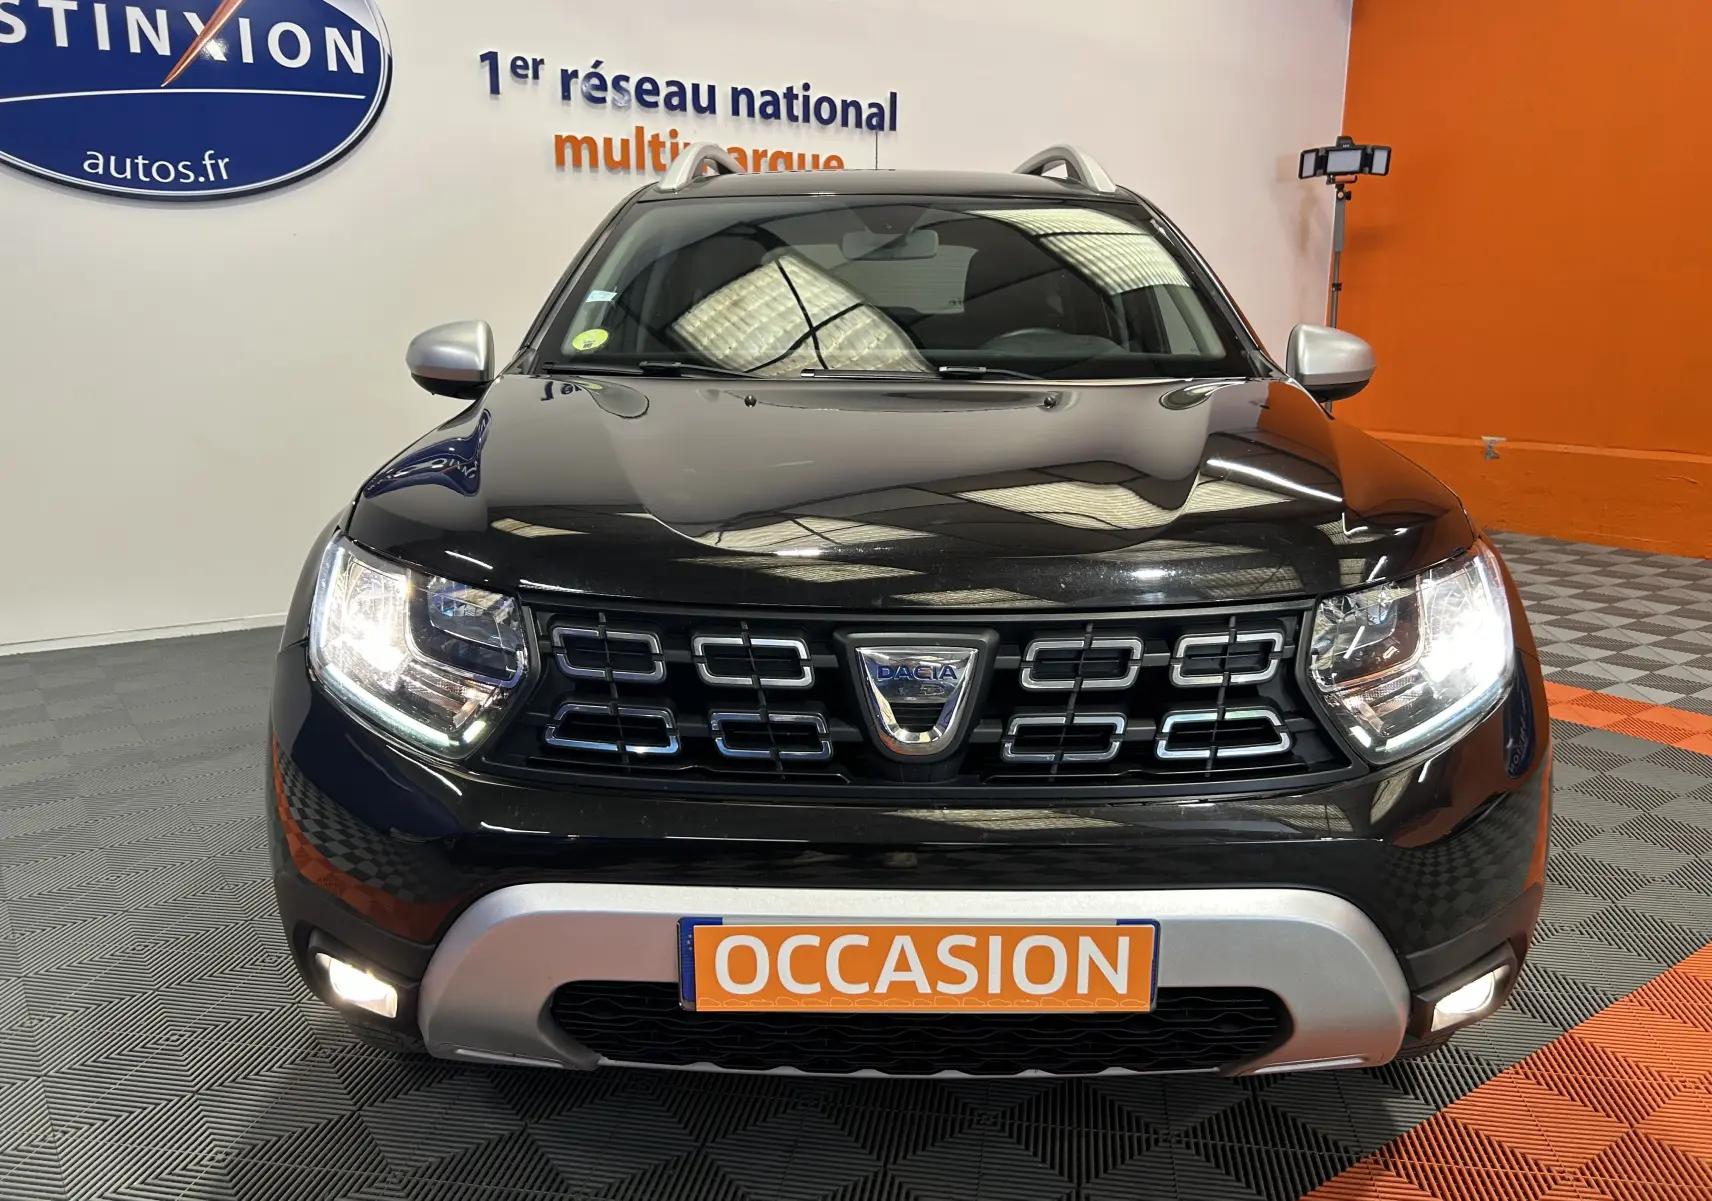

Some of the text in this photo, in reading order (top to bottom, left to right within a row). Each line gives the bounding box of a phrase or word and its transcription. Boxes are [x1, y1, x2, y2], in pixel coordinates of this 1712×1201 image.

[560, 59, 717, 115] réseau
[730, 82, 898, 132] national
[82, 149, 230, 184] autos.fr
[554, 125, 846, 173] multiarque
[876, 665, 958, 680] DACIA
[714, 934, 1131, 995] OCCASION
